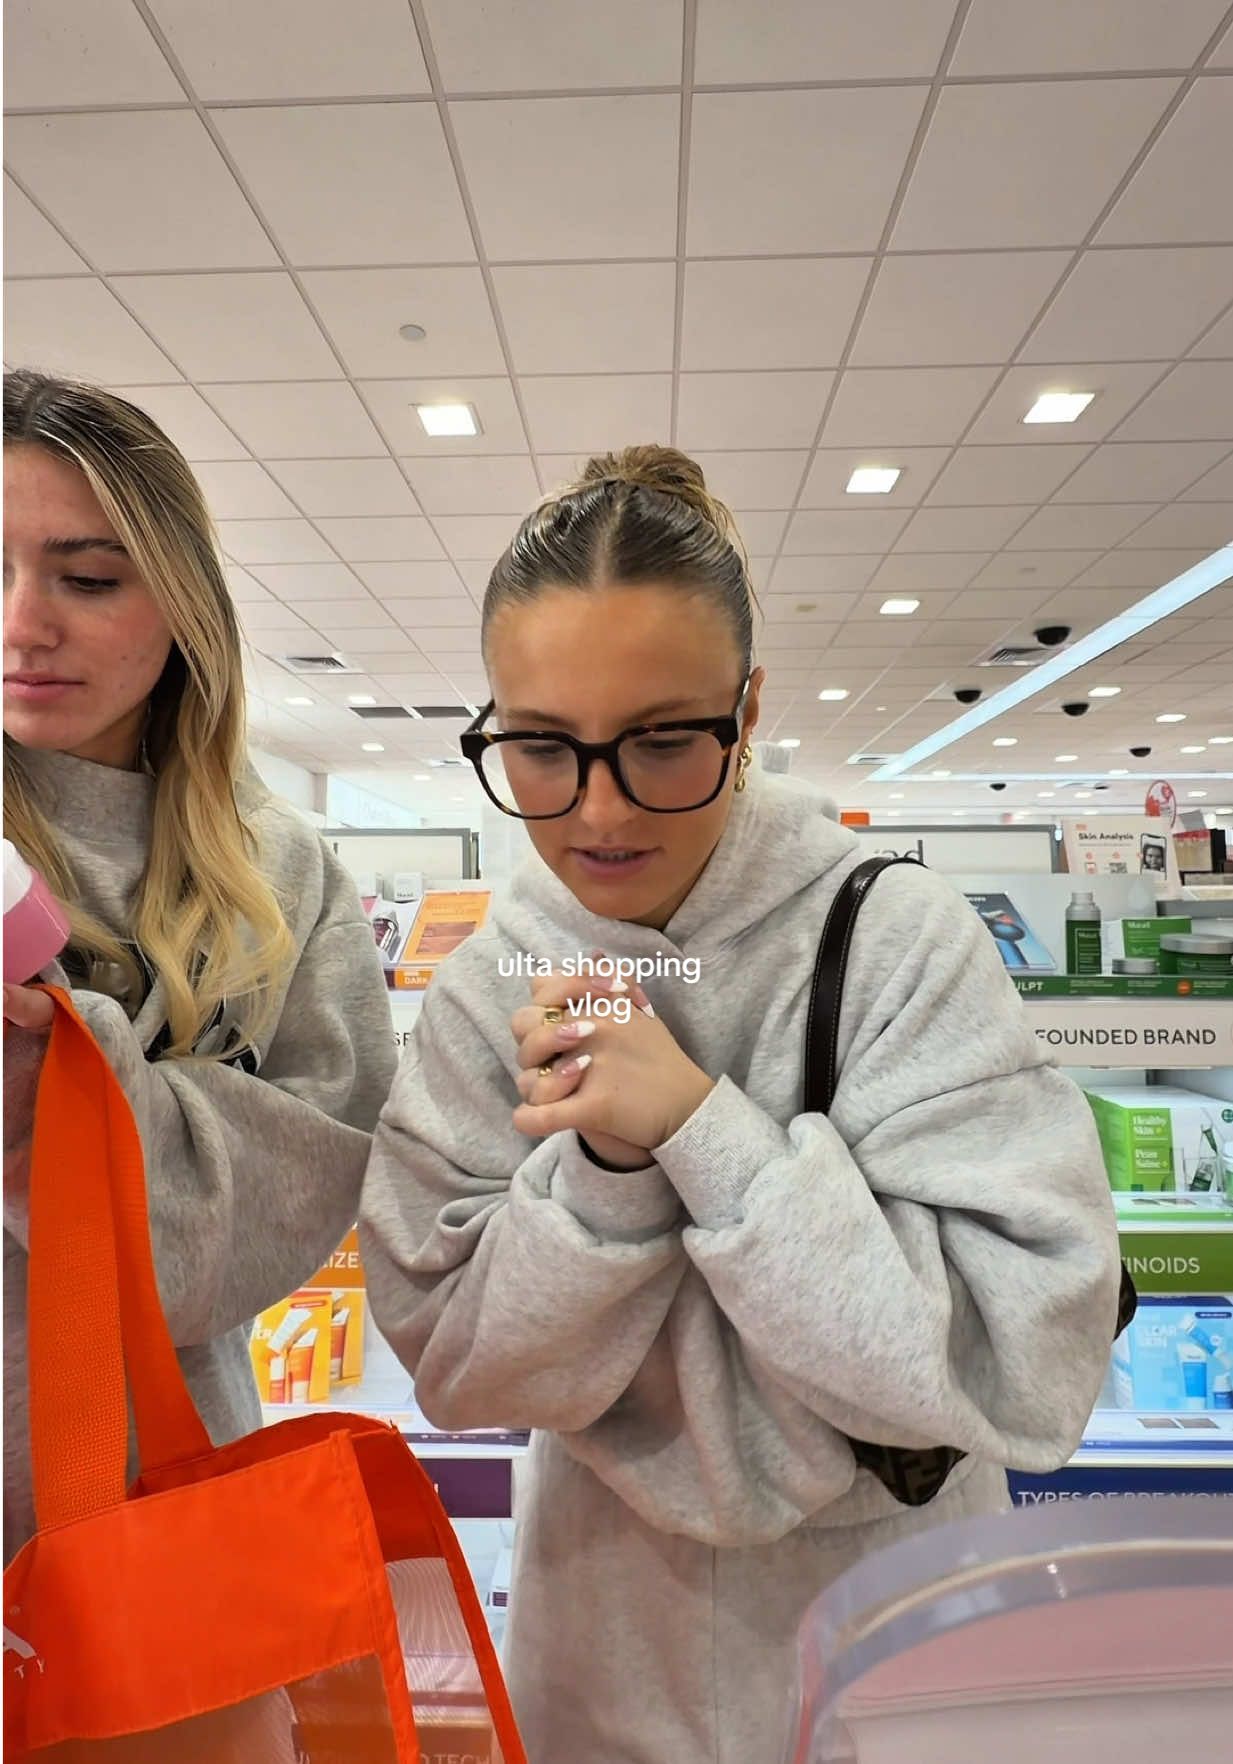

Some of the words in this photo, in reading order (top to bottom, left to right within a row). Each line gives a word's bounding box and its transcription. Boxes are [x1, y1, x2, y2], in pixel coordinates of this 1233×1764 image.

[1078, 832, 1097, 841] Skin
[1099, 832, 1134, 842] Analysis
[1143, 1029, 1217, 1045] BRAND
[323, 1252, 360, 1268] IZE
